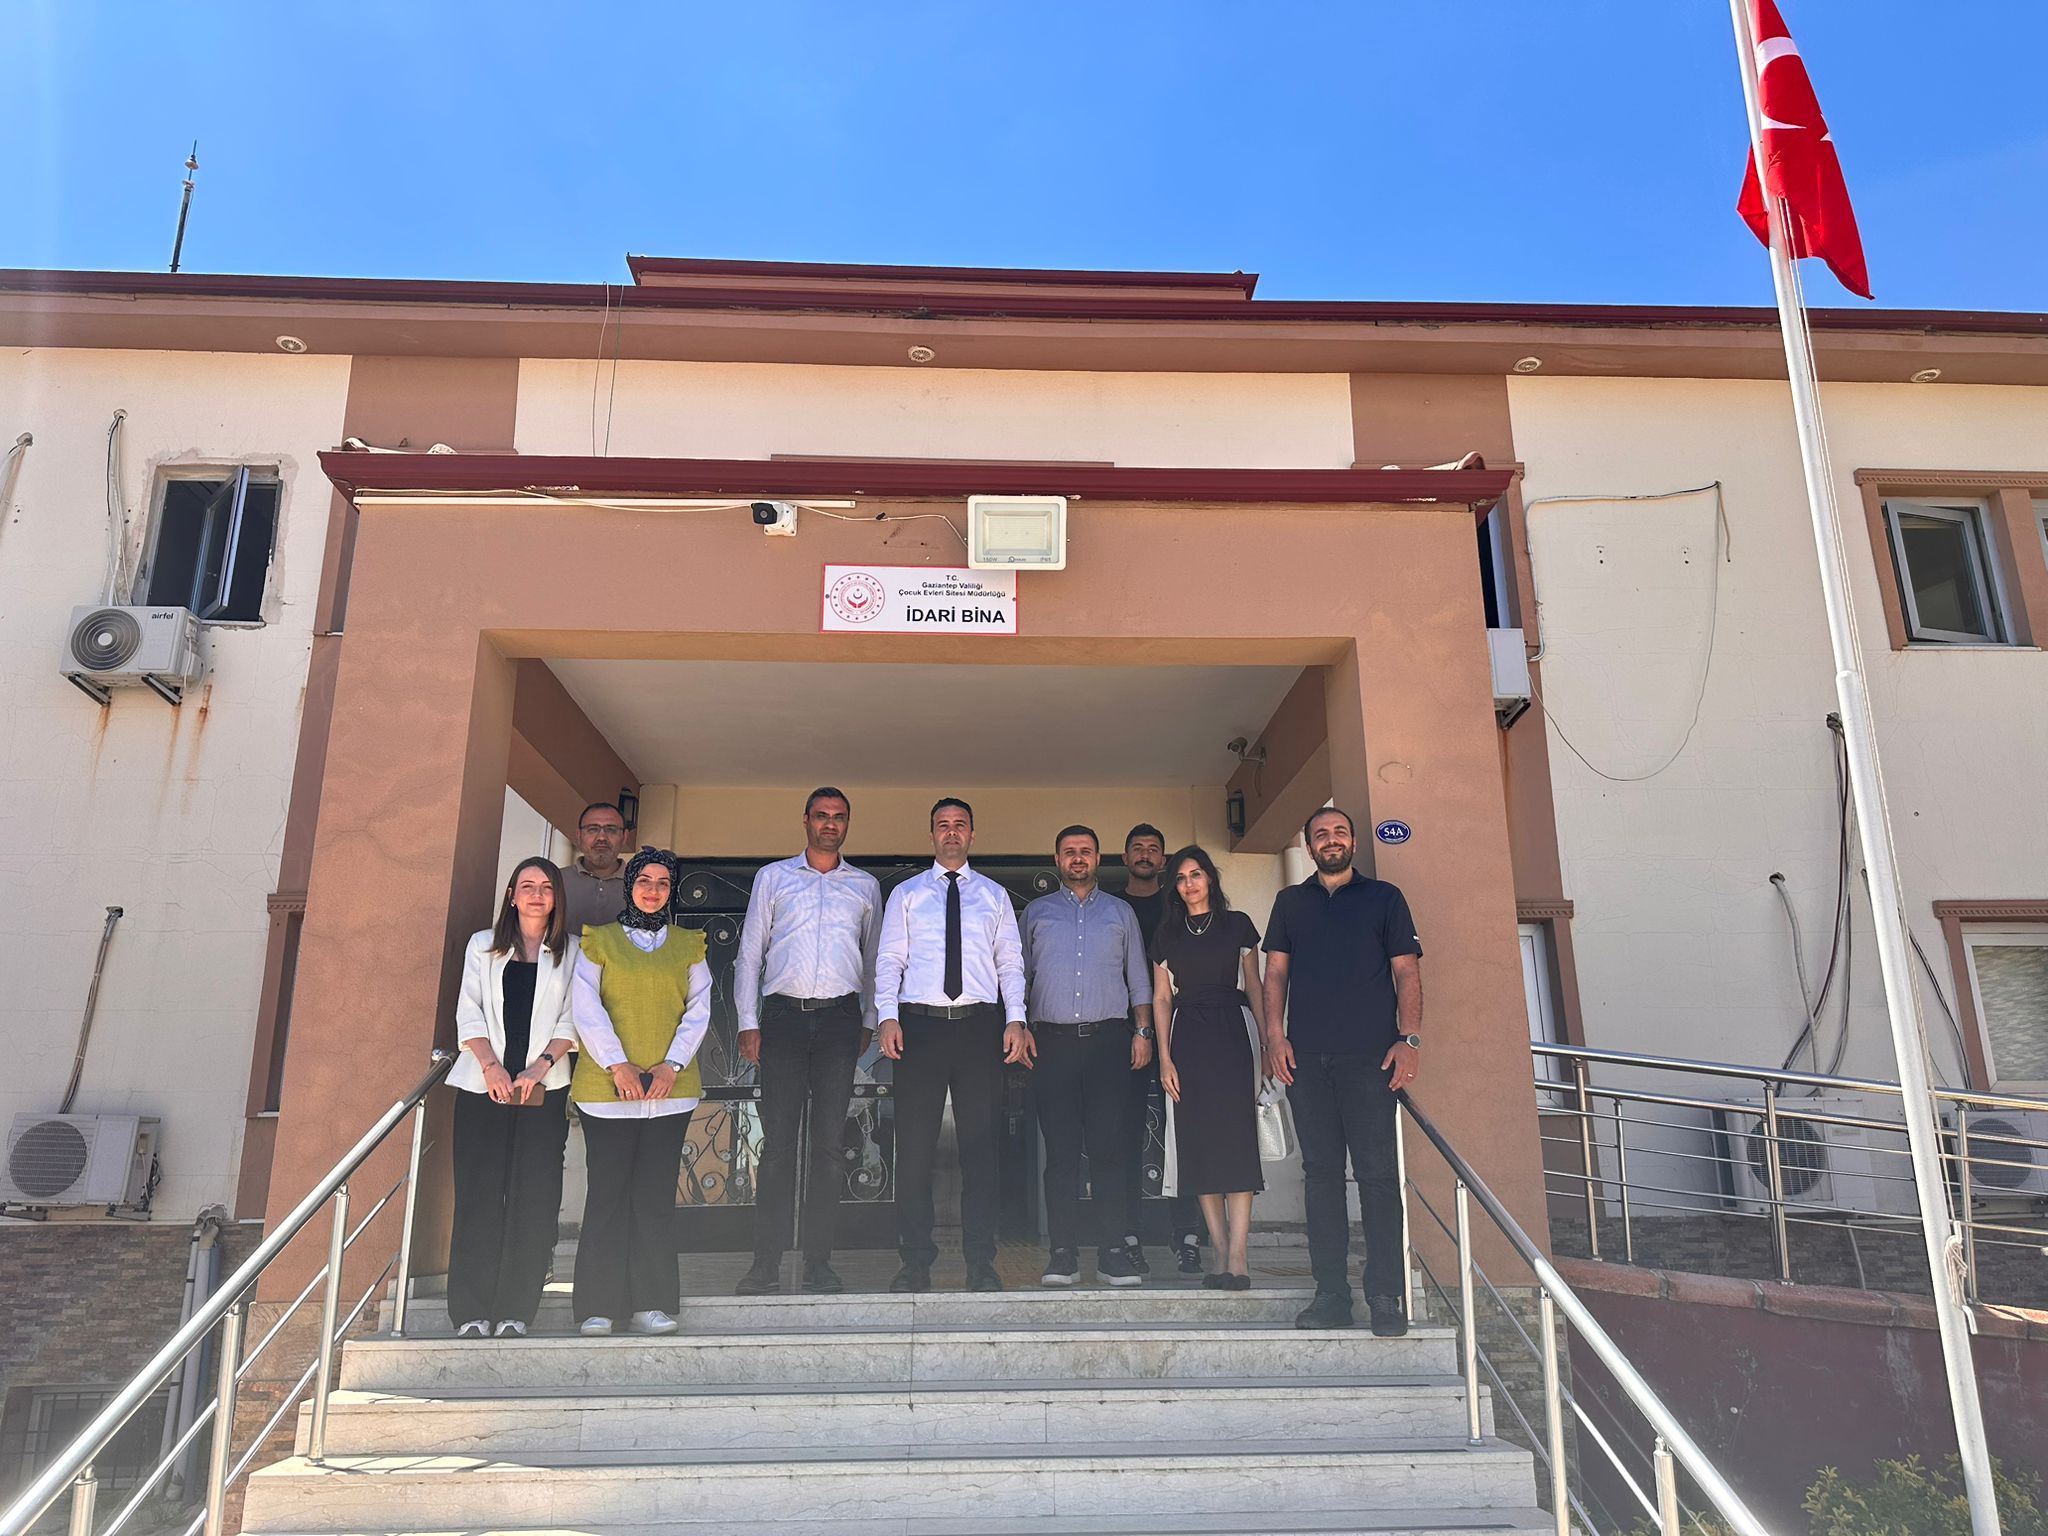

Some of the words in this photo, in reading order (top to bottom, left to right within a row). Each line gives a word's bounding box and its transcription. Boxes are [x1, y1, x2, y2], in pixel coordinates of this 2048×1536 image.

[922, 582, 958, 590] Gaziantep
[898, 588, 922, 596] Çocuk
[967, 589, 1006, 598] Müdürlüğü
[151, 612, 174, 620] airfel
[906, 605, 955, 623] İDARİ
[961, 606, 1006, 624] BİNA
